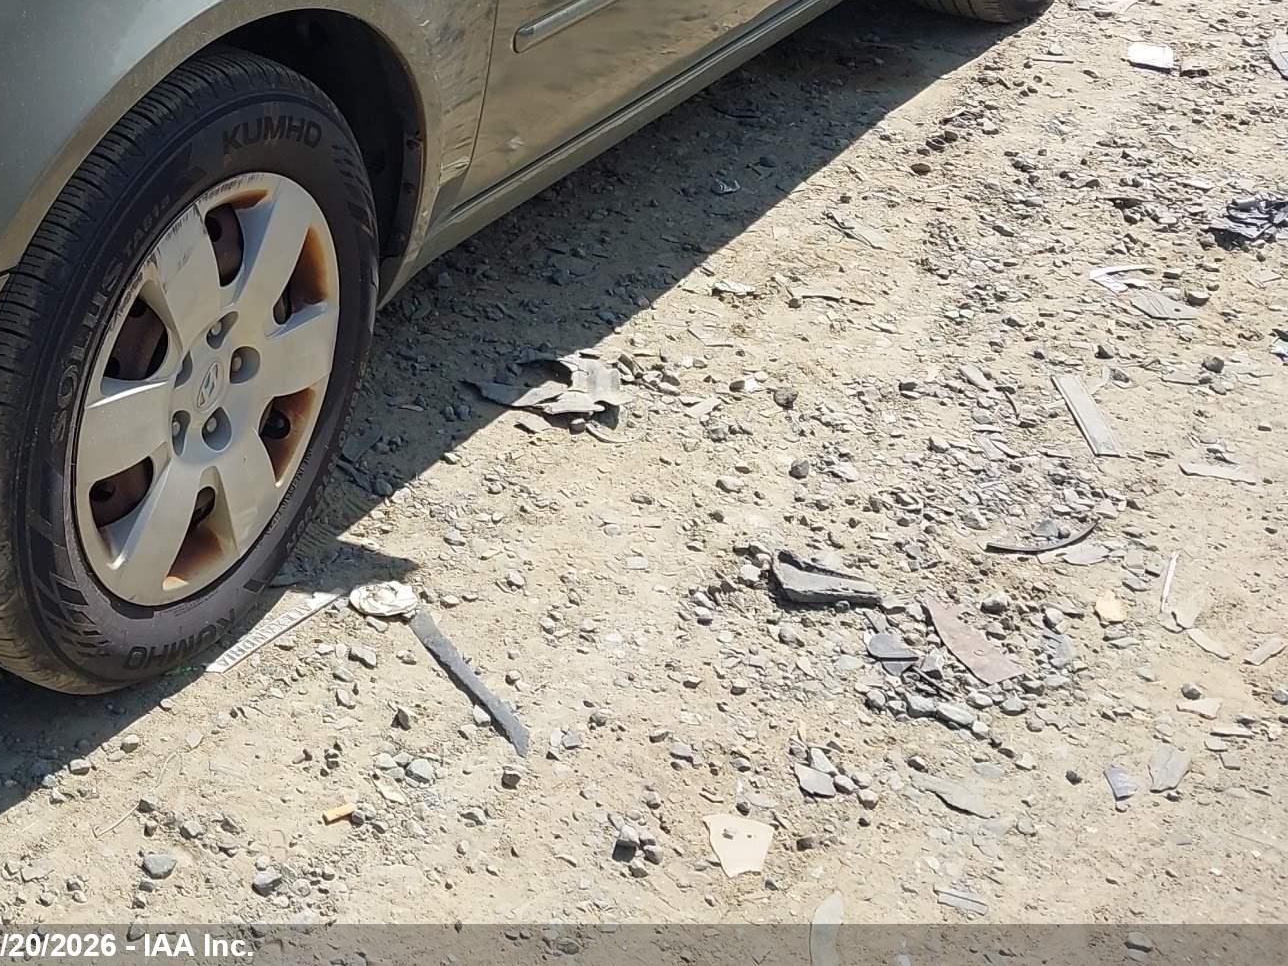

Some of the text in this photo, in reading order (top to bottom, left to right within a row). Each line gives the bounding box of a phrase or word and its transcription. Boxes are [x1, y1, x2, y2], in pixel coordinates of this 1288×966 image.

[222, 115, 323, 155] KUMHO
[49, 257, 125, 444] SOLUS
[123, 607, 236, 670] KUMHO
